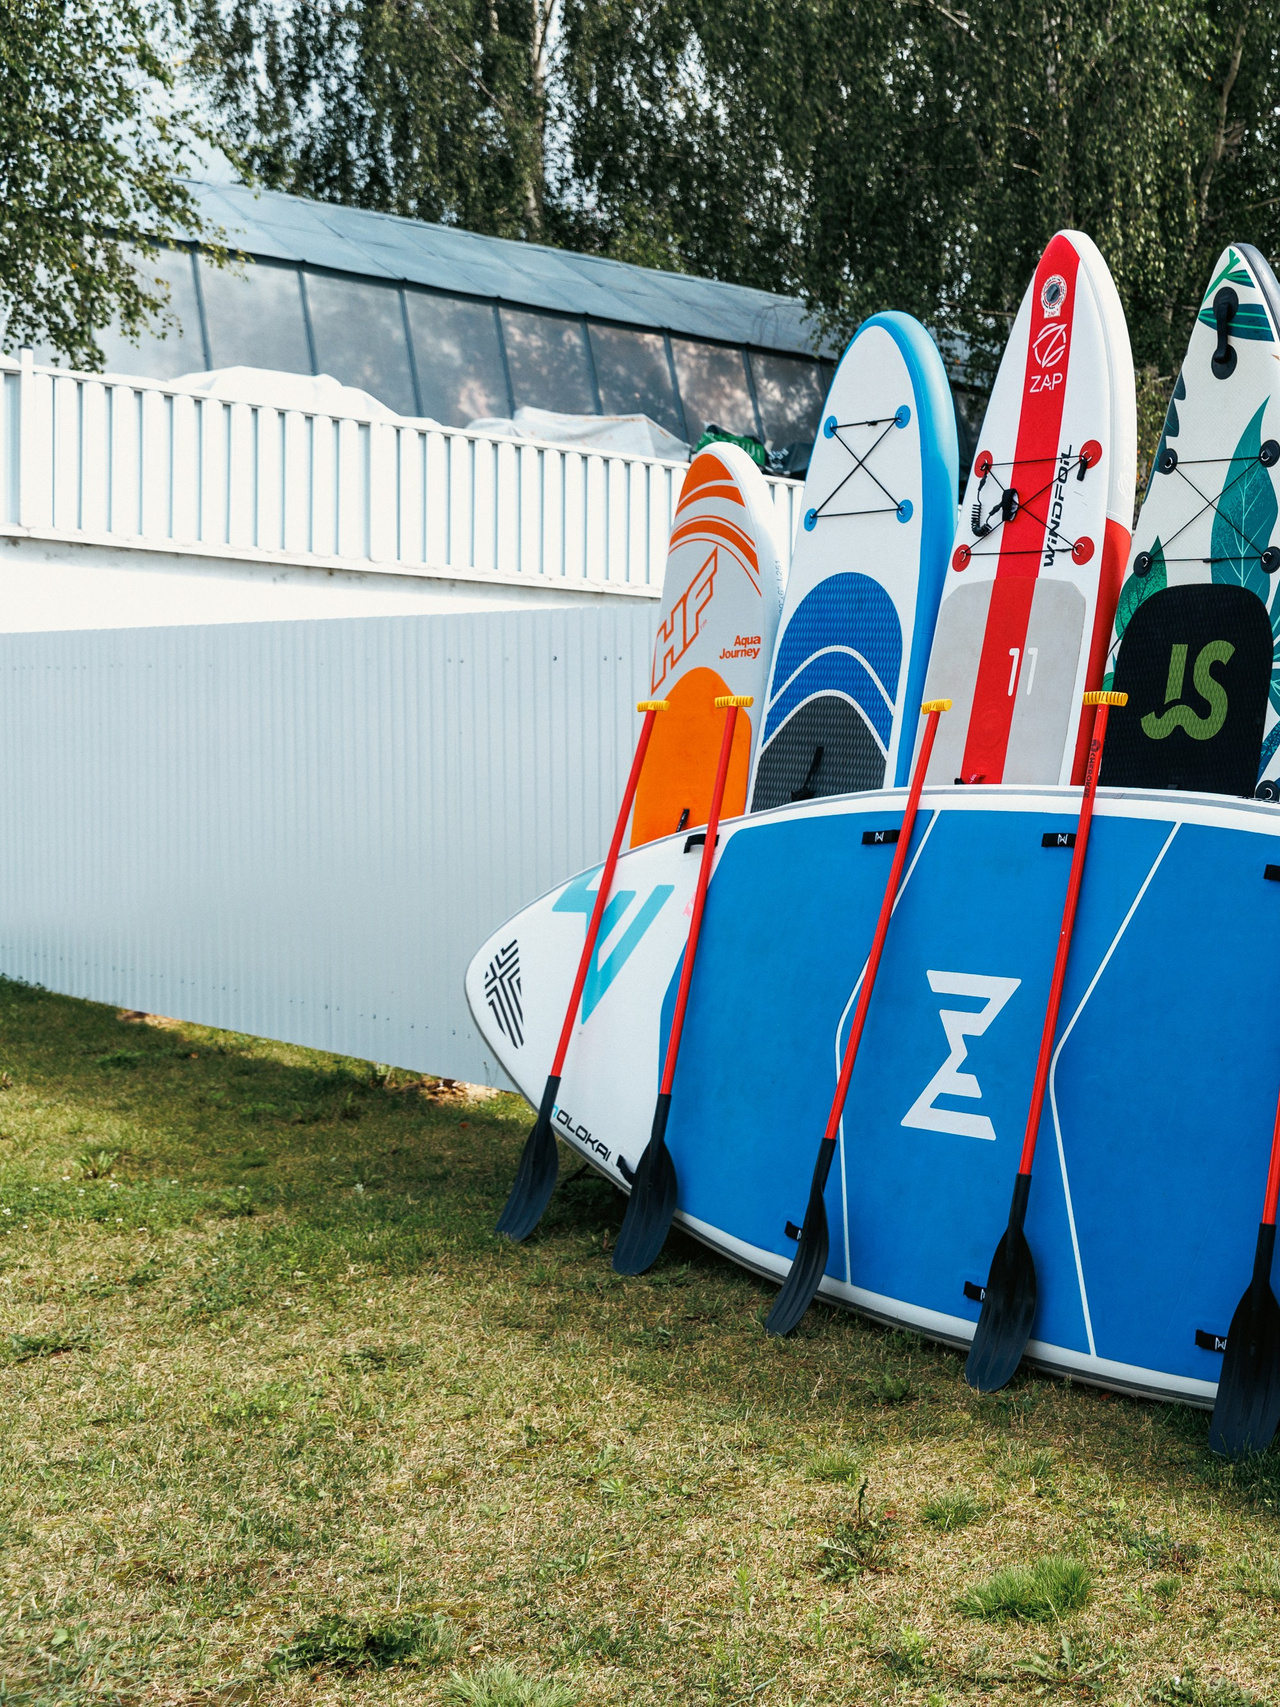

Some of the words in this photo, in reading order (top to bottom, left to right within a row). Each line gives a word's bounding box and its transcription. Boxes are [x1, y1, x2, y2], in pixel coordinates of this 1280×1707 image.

[1029, 372, 1063, 393] ZAP
[650, 545, 718, 696] HF
[734, 635, 761, 648] Aqua
[719, 647, 761, 660] Journey
[1007, 647, 1039, 697] 11
